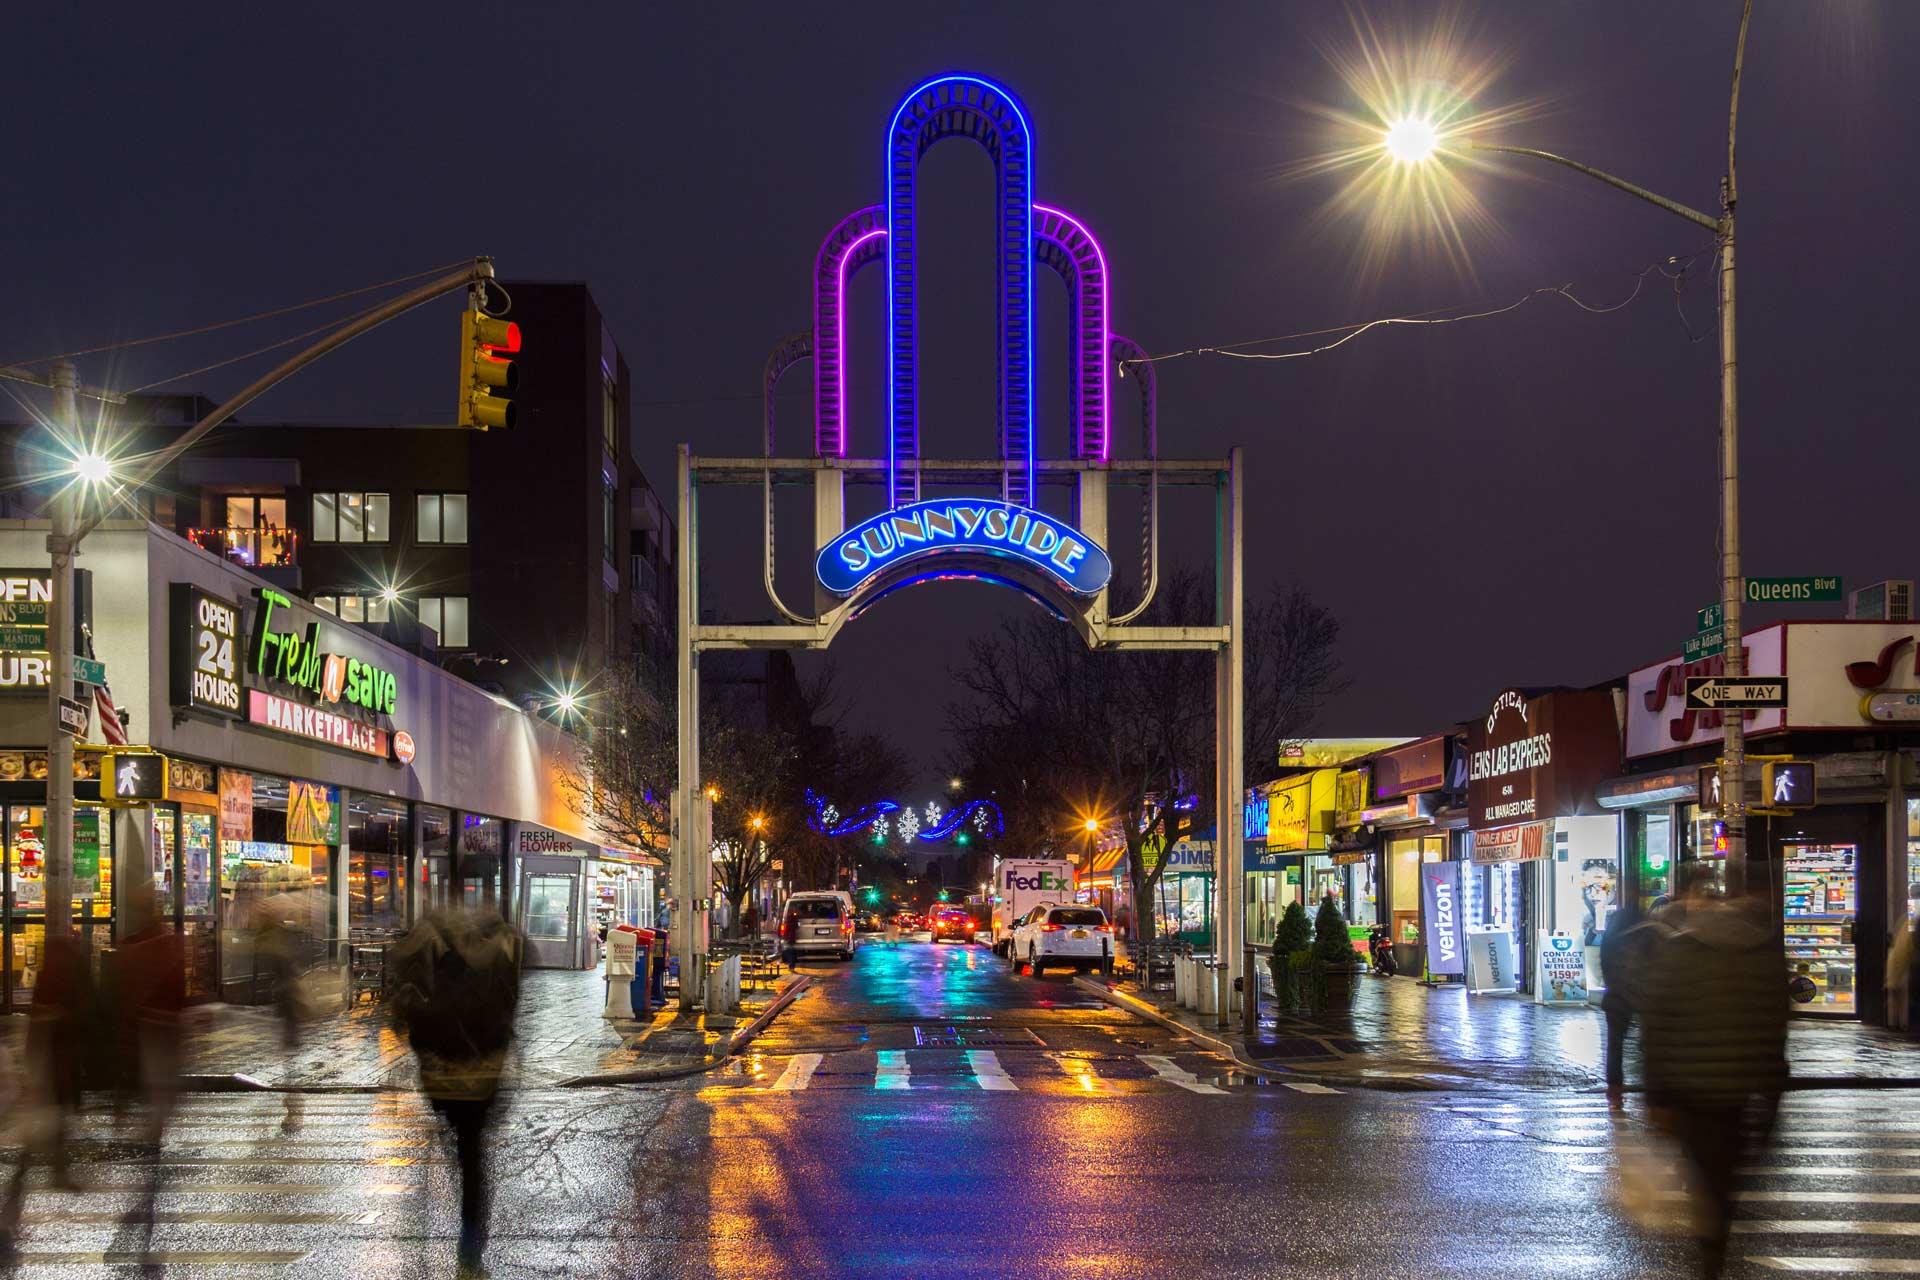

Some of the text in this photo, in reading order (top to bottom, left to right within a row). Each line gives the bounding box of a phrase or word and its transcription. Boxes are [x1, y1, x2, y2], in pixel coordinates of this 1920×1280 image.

[840, 506, 1088, 573] SUNNYSIDE
[0, 579, 52, 602] EN
[1749, 578, 1836, 600] Queens Blvd
[19, 604, 45, 614] BLVD
[199, 598, 234, 637] OPEN
[1704, 608, 1714, 627] 46
[4, 634, 40, 645] MANTON
[1686, 632, 1723, 653] Luke Adams
[199, 631, 234, 679] 24
[258, 588, 320, 693] Fresh
[347, 659, 397, 715] save
[0, 657, 51, 686] UR
[73, 662, 88, 680] 46
[194, 671, 239, 710] HOURS
[1702, 686, 1775, 699] ONE WAY
[1487, 691, 1528, 735] OPTICAL
[267, 696, 376, 753] MARKETPLACE
[1470, 750, 1491, 780] LENS
[1491, 745, 1508, 776] LAB
[1510, 733, 1551, 772] EXPRESS
[1485, 799, 1535, 820] ALL MANAGED CARE
[520, 831, 554, 842] FRESH
[520, 842, 573, 852] FLOWERS
[1477, 828, 1518, 846] UNDER NEW
[1520, 823, 1544, 858] NOW
[1260, 855, 1277, 865] ATM
[1006, 871, 1068, 891] FedEx
[1434, 883, 1455, 962] verizon
[1489, 942, 1500, 984] verizon
